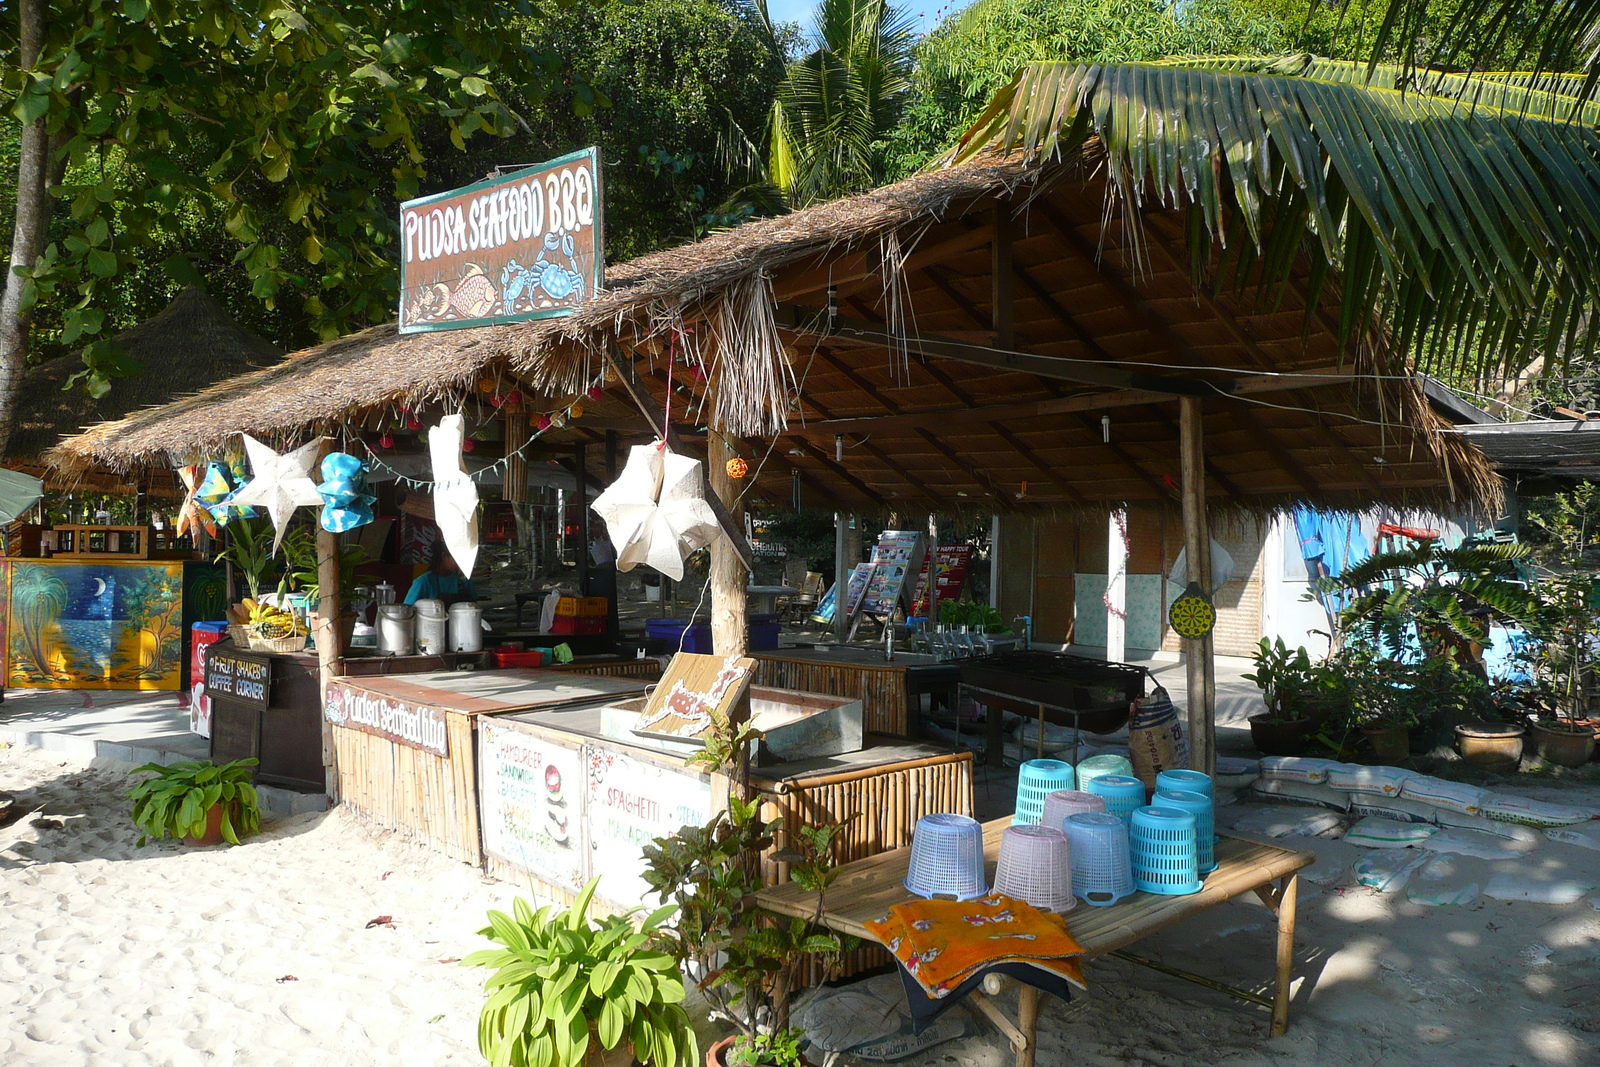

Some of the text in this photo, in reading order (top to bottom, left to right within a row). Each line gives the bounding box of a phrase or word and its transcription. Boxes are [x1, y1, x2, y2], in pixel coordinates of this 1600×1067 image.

[405, 202, 468, 263] PUDSA
[468, 178, 545, 251] SEAFOOD
[214, 655, 261, 680] FRUIT SHAKES
[208, 672, 264, 700] COFFEE CORNER
[342, 688, 380, 728] Pudsa
[380, 698, 423, 744] Seafood
[500, 741, 543, 770] HAMBURGER
[501, 781, 539, 808] BAGUETTE
[607, 787, 703, 828] SPAGHETTI STEAK
[608, 817, 661, 848] MACARO
